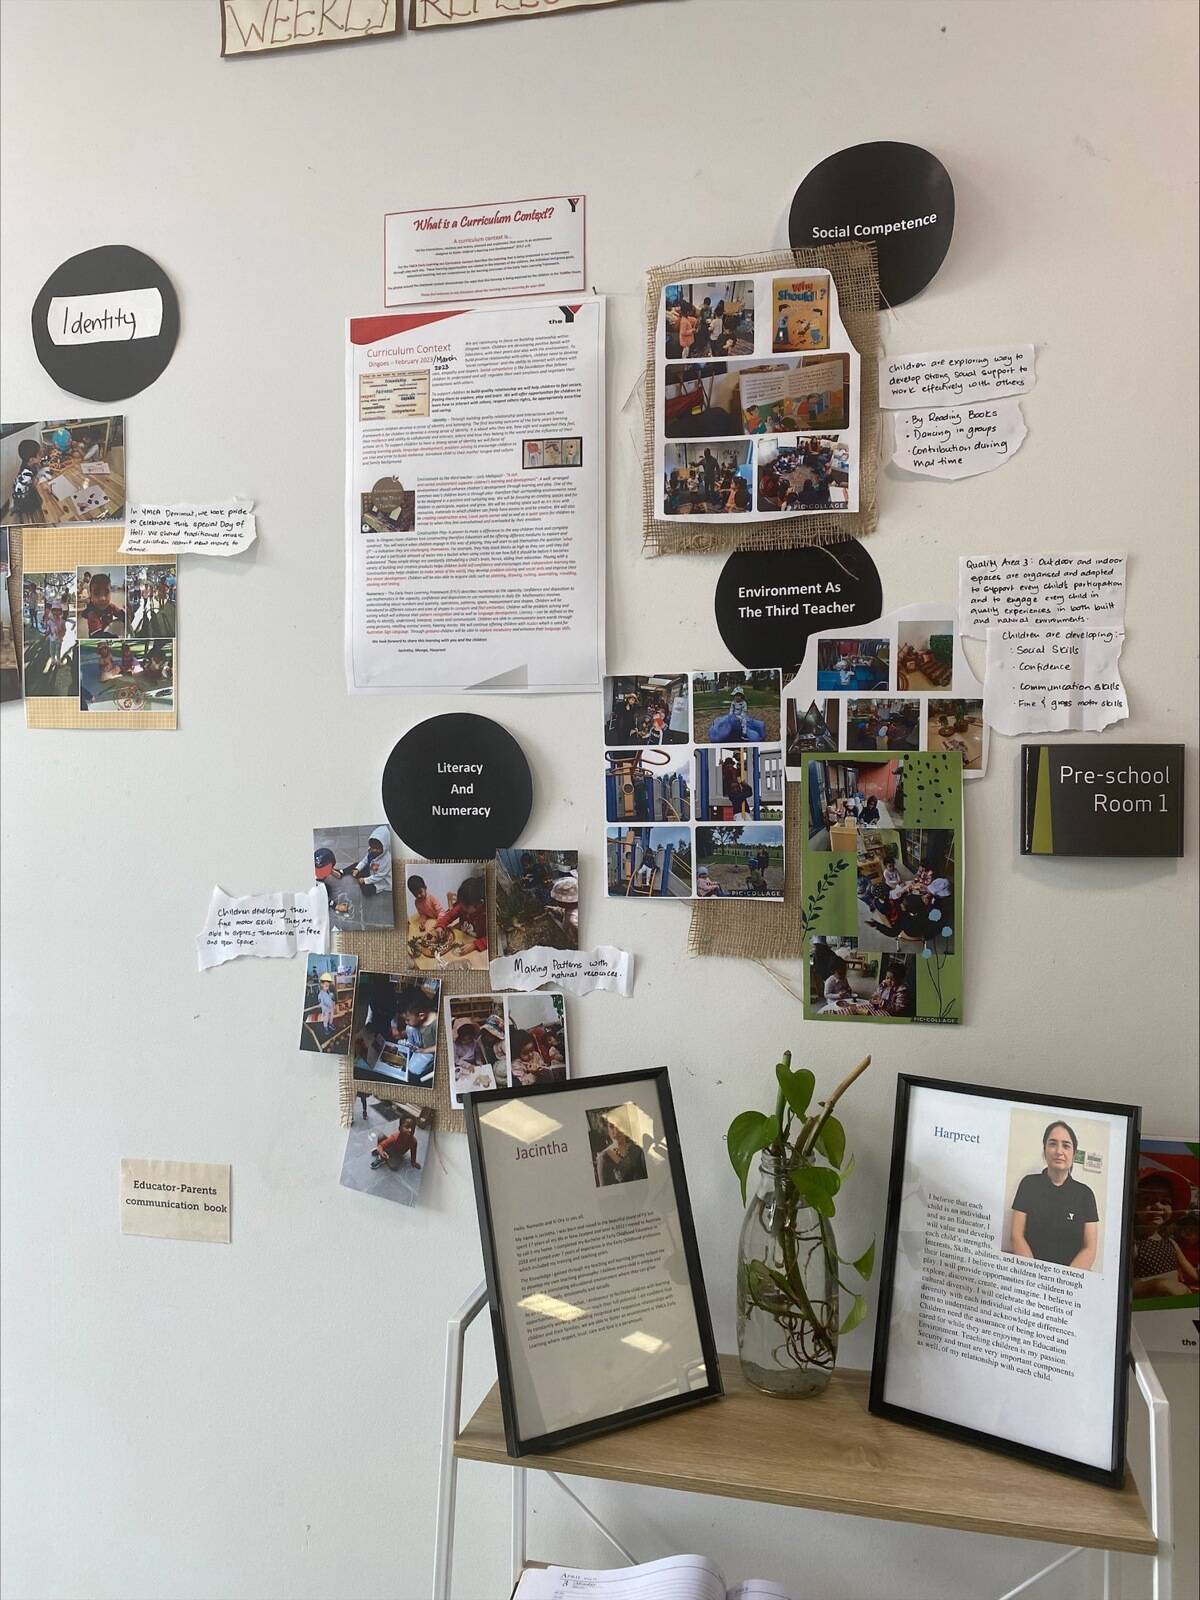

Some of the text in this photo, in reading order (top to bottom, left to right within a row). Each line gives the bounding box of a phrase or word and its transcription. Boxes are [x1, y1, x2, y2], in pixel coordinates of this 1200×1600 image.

[413, 216, 442, 231] What
[443, 219, 450, 230] is
[460, 210, 511, 228] Curriculum
[513, 207, 554, 223] Context?
[812, 213, 937, 239] Social Competence
[63, 306, 136, 340] Identity
[367, 344, 451, 358] Curriculum Context
[395, 358, 419, 366] February
[930, 359, 945, 367] are
[949, 358, 989, 368] exploring
[889, 375, 921, 385] develop
[924, 373, 950, 384] strong
[1019, 365, 1028, 373] to
[892, 387, 916, 395] work
[922, 383, 963, 395] effectively
[968, 380, 990, 388] with
[912, 409, 998, 429] By Reading Books
[913, 426, 951, 443] Dancing
[966, 425, 997, 439] groups
[912, 440, 1008, 456] Contribution during
[937, 457, 963, 465] time
[141, 508, 161, 516] YMCA
[227, 508, 248, 517] pride
[966, 559, 997, 572] Quality
[1001, 557, 1020, 567] Area
[1076, 558, 1092, 566] and
[1063, 569, 1078, 577] and
[1080, 568, 1114, 578] adapted
[738, 582, 841, 598] Environment As
[1019, 584, 1039, 595] every
[1074, 580, 1123, 591] participation
[970, 596, 988, 604] and
[1006, 597, 1038, 607] engage
[1045, 595, 1064, 605] every
[1090, 590, 1099, 598] in
[738, 602, 856, 618] The Third Teacher
[1004, 608, 1051, 616] experiences
[1070, 604, 1091, 612] both
[1094, 602, 1115, 611] built
[1002, 631, 1040, 640] Children
[1016, 644, 1079, 655] Social Skills
[1019, 662, 1071, 672] Confidence
[1020, 681, 1120, 691] Communication skills
[1018, 699, 1037, 708] Fine
[1051, 700, 1072, 711] gross
[1101, 699, 1123, 708] skills
[437, 762, 483, 775] Literacy
[1060, 765, 1170, 784] Pre-school
[450, 783, 474, 795] And
[1094, 793, 1168, 812] Room 1
[432, 805, 491, 818] Numeracy
[218, 919, 231, 929] fine
[285, 918, 300, 928] They
[514, 958, 608, 977] Making Patterns with
[551, 971, 578, 979] natural
[934, 1126, 980, 1144] Harpreet
[514, 1140, 568, 1161] Jacintha
[133, 1180, 217, 1195] Educator-Parents
[125, 1198, 228, 1213] communication book
[932, 1194, 954, 1204] believe
[955, 1199, 967, 1207] that
[968, 1202, 982, 1210] each
[919, 1300, 945, 1314] Children
[947, 1310, 962, 1318] need
[963, 1312, 973, 1321] the
[974, 1317, 1005, 1331] assurance
[1016, 1325, 1034, 1338] being
[1035, 1330, 1054, 1342] loved
[1056, 1337, 1068, 1345] and
[1182, 1338, 1197, 1347] the
[949, 1348, 958, 1357] my
[961, 1351, 998, 1368] relationship
[1000, 1362, 1014, 1371] with
[1015, 1367, 1031, 1376] each
